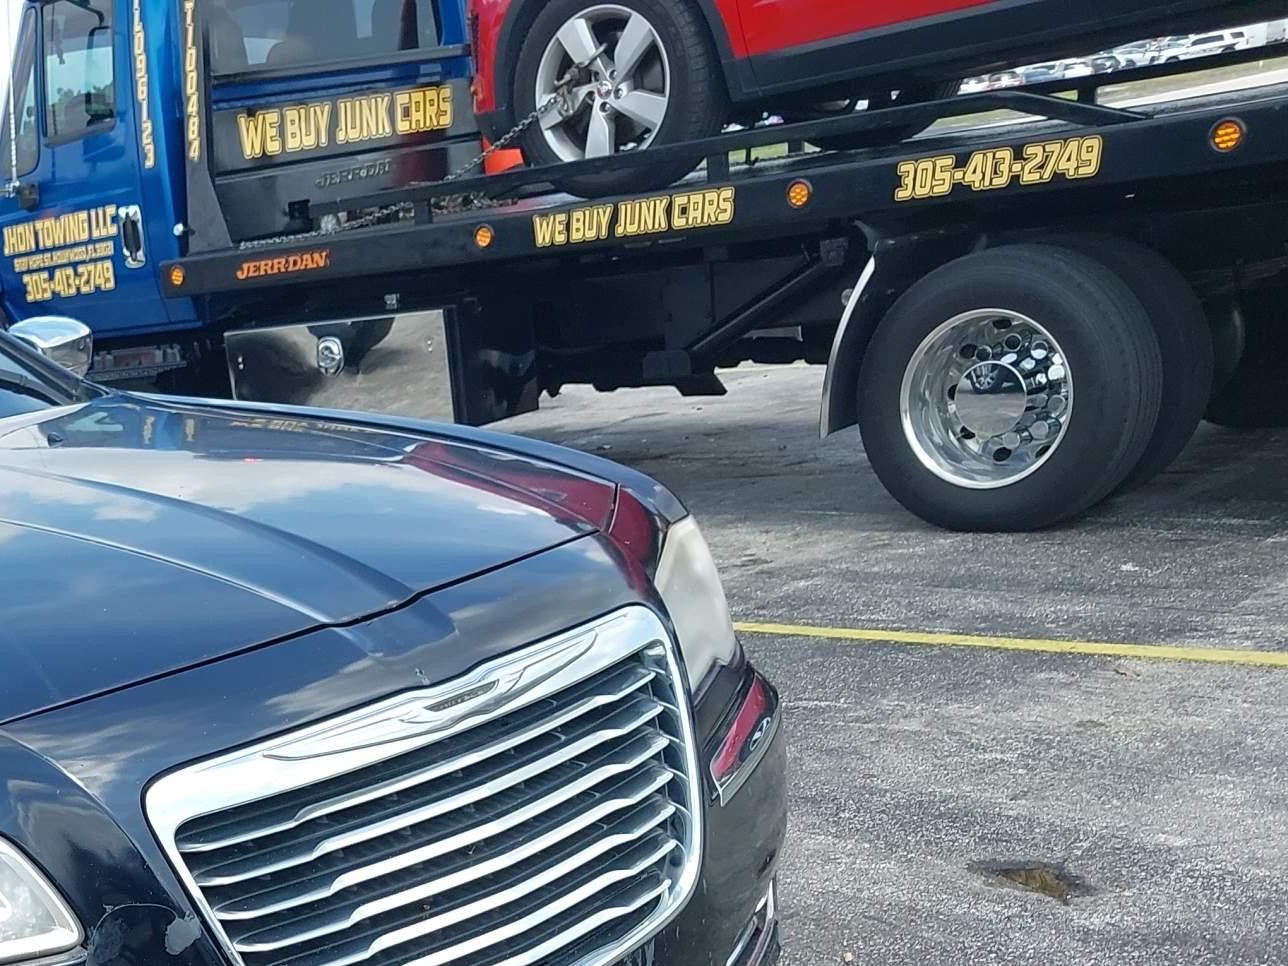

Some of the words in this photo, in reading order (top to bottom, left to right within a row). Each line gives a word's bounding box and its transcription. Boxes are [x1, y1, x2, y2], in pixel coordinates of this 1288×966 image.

[238, 110, 281, 159] WE
[284, 102, 331, 152] BUY
[336, 93, 392, 144] JUNK
[394, 85, 453, 134] CARS
[895, 135, 1102, 201] 305-413-2749
[3, 221, 36, 256] JHON
[35, 210, 89, 250] TOWING
[90, 204, 118, 240] LLC
[533, 213, 567, 247] WE
[570, 203, 613, 243] BUY
[615, 196, 670, 237] JUNK
[671, 187, 735, 229] CARS
[23, 259, 115, 302] 305-413-2749
